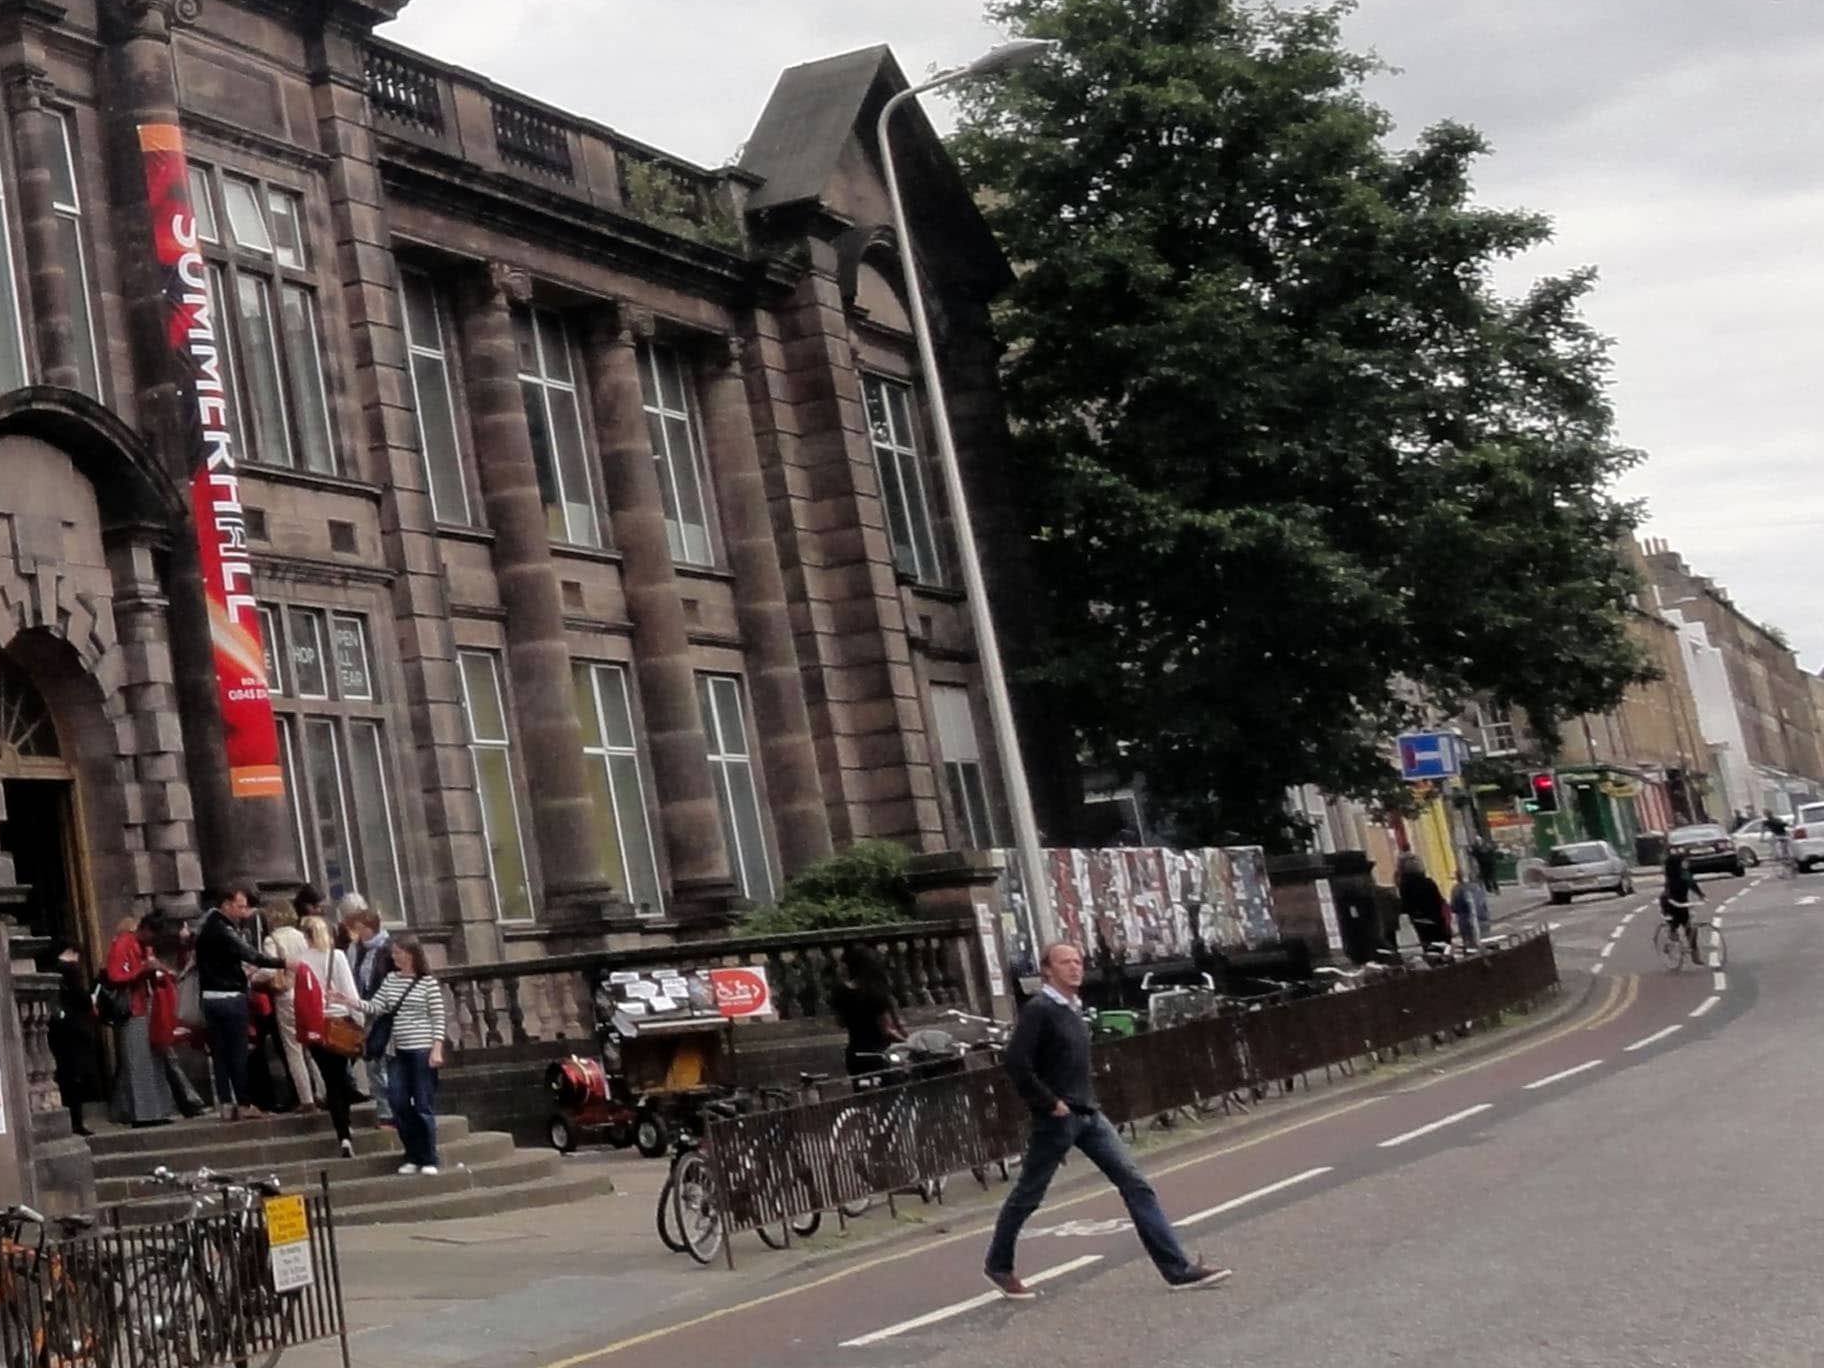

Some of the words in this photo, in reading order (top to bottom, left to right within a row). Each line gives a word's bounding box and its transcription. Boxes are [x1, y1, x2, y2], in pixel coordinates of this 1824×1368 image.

[171, 214, 257, 624] SUMMERHALL
[334, 629, 359, 648] PEN
[340, 669, 364, 687] EAR
